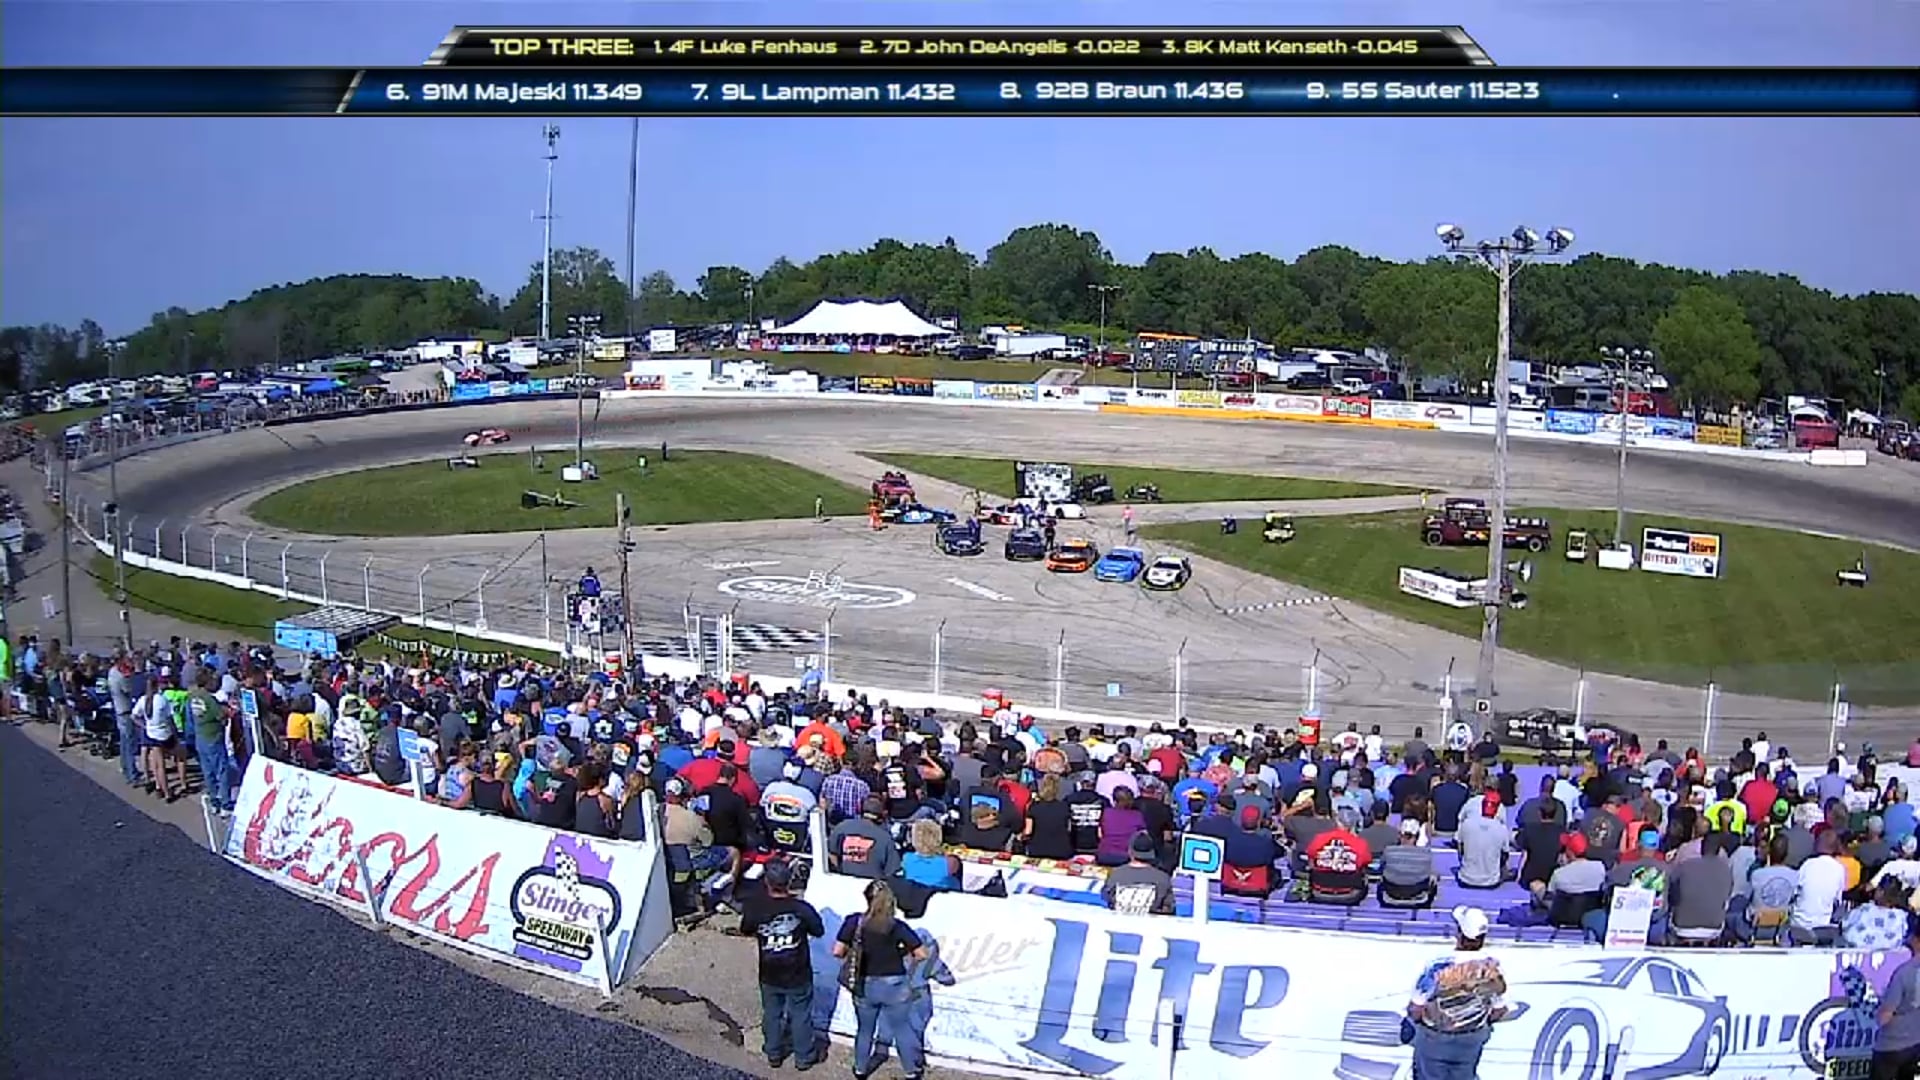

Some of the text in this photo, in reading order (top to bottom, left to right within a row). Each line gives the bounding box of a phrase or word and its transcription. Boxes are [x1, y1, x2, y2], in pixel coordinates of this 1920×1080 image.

[1478, 701, 1488, 712] D
[1181, 836, 1222, 874] D
[520, 881, 611, 923] Slinger
[525, 916, 586, 945] SPEEDWAY
[937, 931, 1043, 973] iller
[1016, 917, 1291, 1076] Lite
[1828, 1058, 1871, 1078] SPEED
